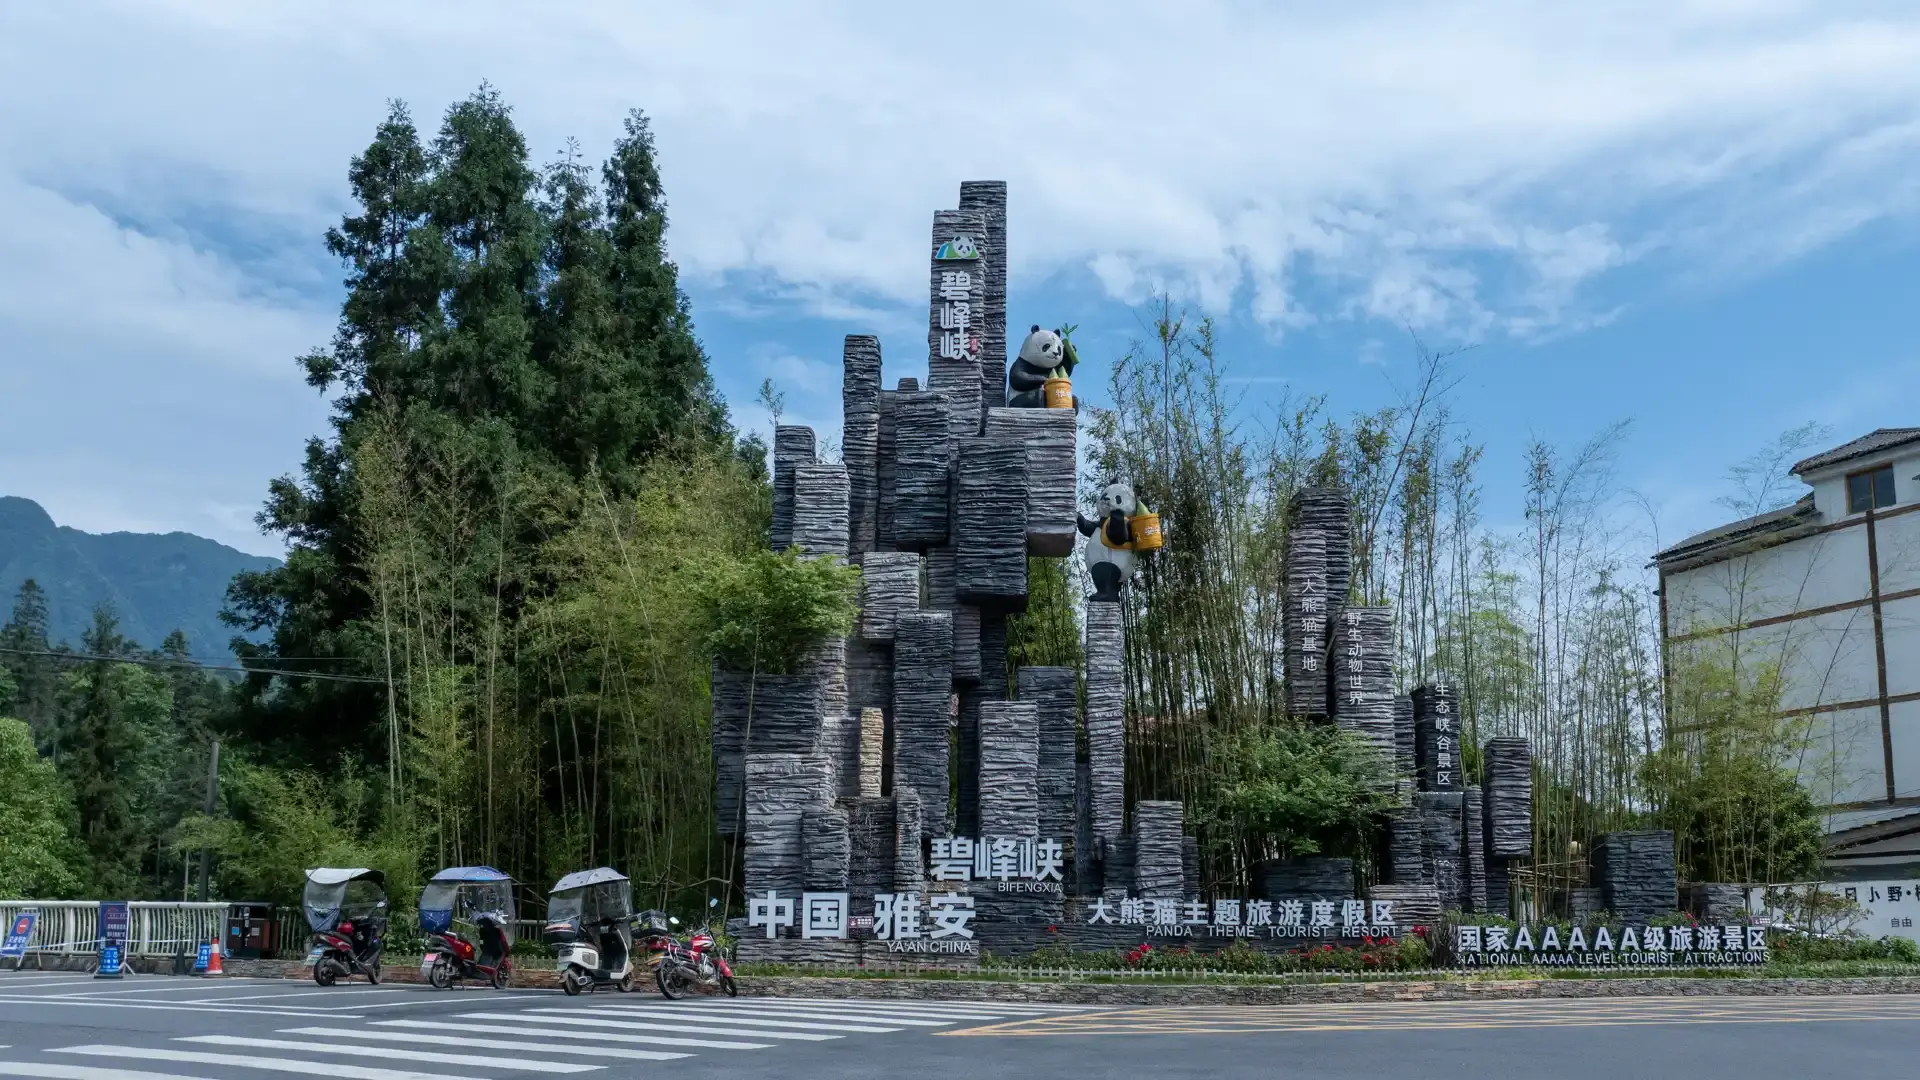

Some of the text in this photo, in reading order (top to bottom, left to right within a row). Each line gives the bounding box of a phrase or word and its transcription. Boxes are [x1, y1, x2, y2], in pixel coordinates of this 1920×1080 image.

[938, 270, 976, 362] 碧峰峡
[1301, 578, 1318, 672] 大熊猫基地
[1347, 611, 1364, 705] 野生动物世界
[1435, 683, 1452, 786] 生态峡谷景区
[930, 837, 1064, 882] 碧峰峡
[997, 882, 1063, 893] BIFENGXIA
[749, 890, 977, 940] 中国 雅安
[1087, 897, 1398, 926] 大熊猫主题旅游度假区
[929, 940, 973, 953] CHINA
[1146, 925, 1399, 938] PANDA THEME TOURIST RESORT
[1457, 925, 1768, 952] 国家AAAAA级旅游景区
[1532, 953, 1574, 965] AAAAA
[1579, 953, 1616, 965] LEVEL
[1622, 953, 1675, 964] TOURIST
[1685, 951, 1771, 964] ATTRACTIONS
